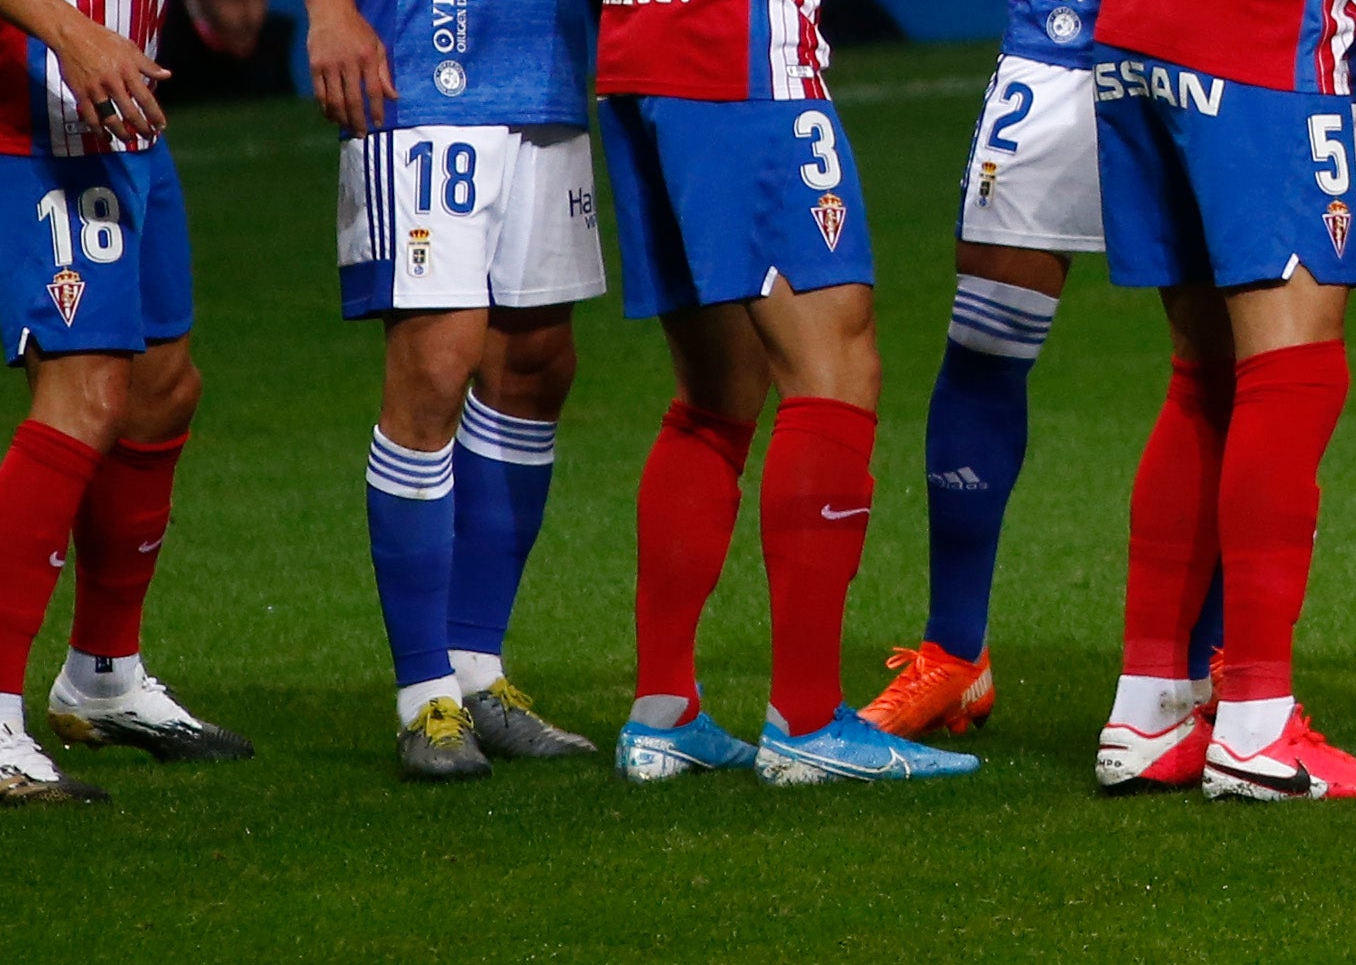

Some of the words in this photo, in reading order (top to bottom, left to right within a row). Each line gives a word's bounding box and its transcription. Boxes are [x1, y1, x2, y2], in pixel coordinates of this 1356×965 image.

[793, 110, 842, 191] 3
[985, 80, 1034, 155] 2
[1307, 114, 1349, 196] 5
[405, 140, 477, 217] 18
[37, 186, 124, 267] 18
